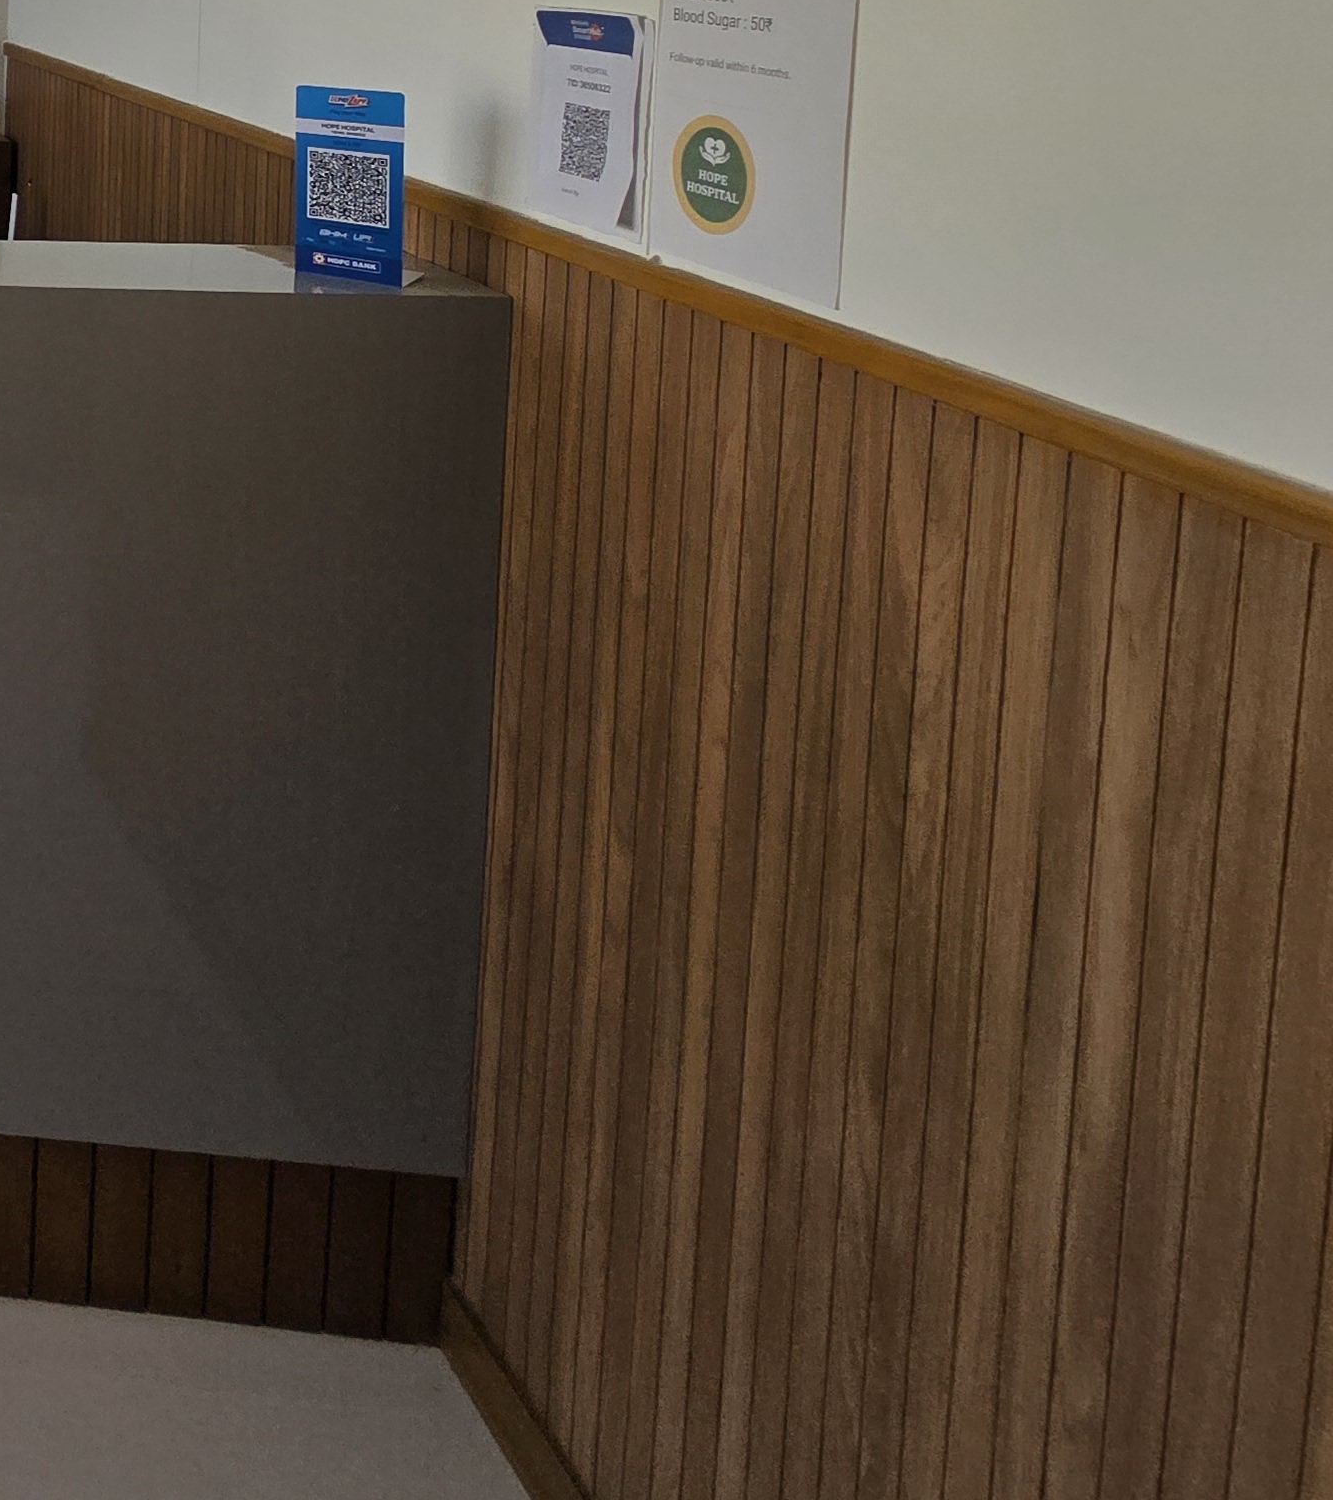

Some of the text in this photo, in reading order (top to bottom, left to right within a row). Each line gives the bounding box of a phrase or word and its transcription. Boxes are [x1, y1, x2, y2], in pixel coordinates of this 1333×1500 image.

[674, 7, 704, 24] Blood
[707, 11, 741, 30] Sugar
[751, 16, 773, 32] 50₹
[706, 55, 724, 68] valid
[725, 61, 750, 73] within
[341, 125, 375, 134] HOSPITAL
[686, 169, 740, 205] HOPE HOSPITAL
[327, 257, 377, 271] HDFC BANK
